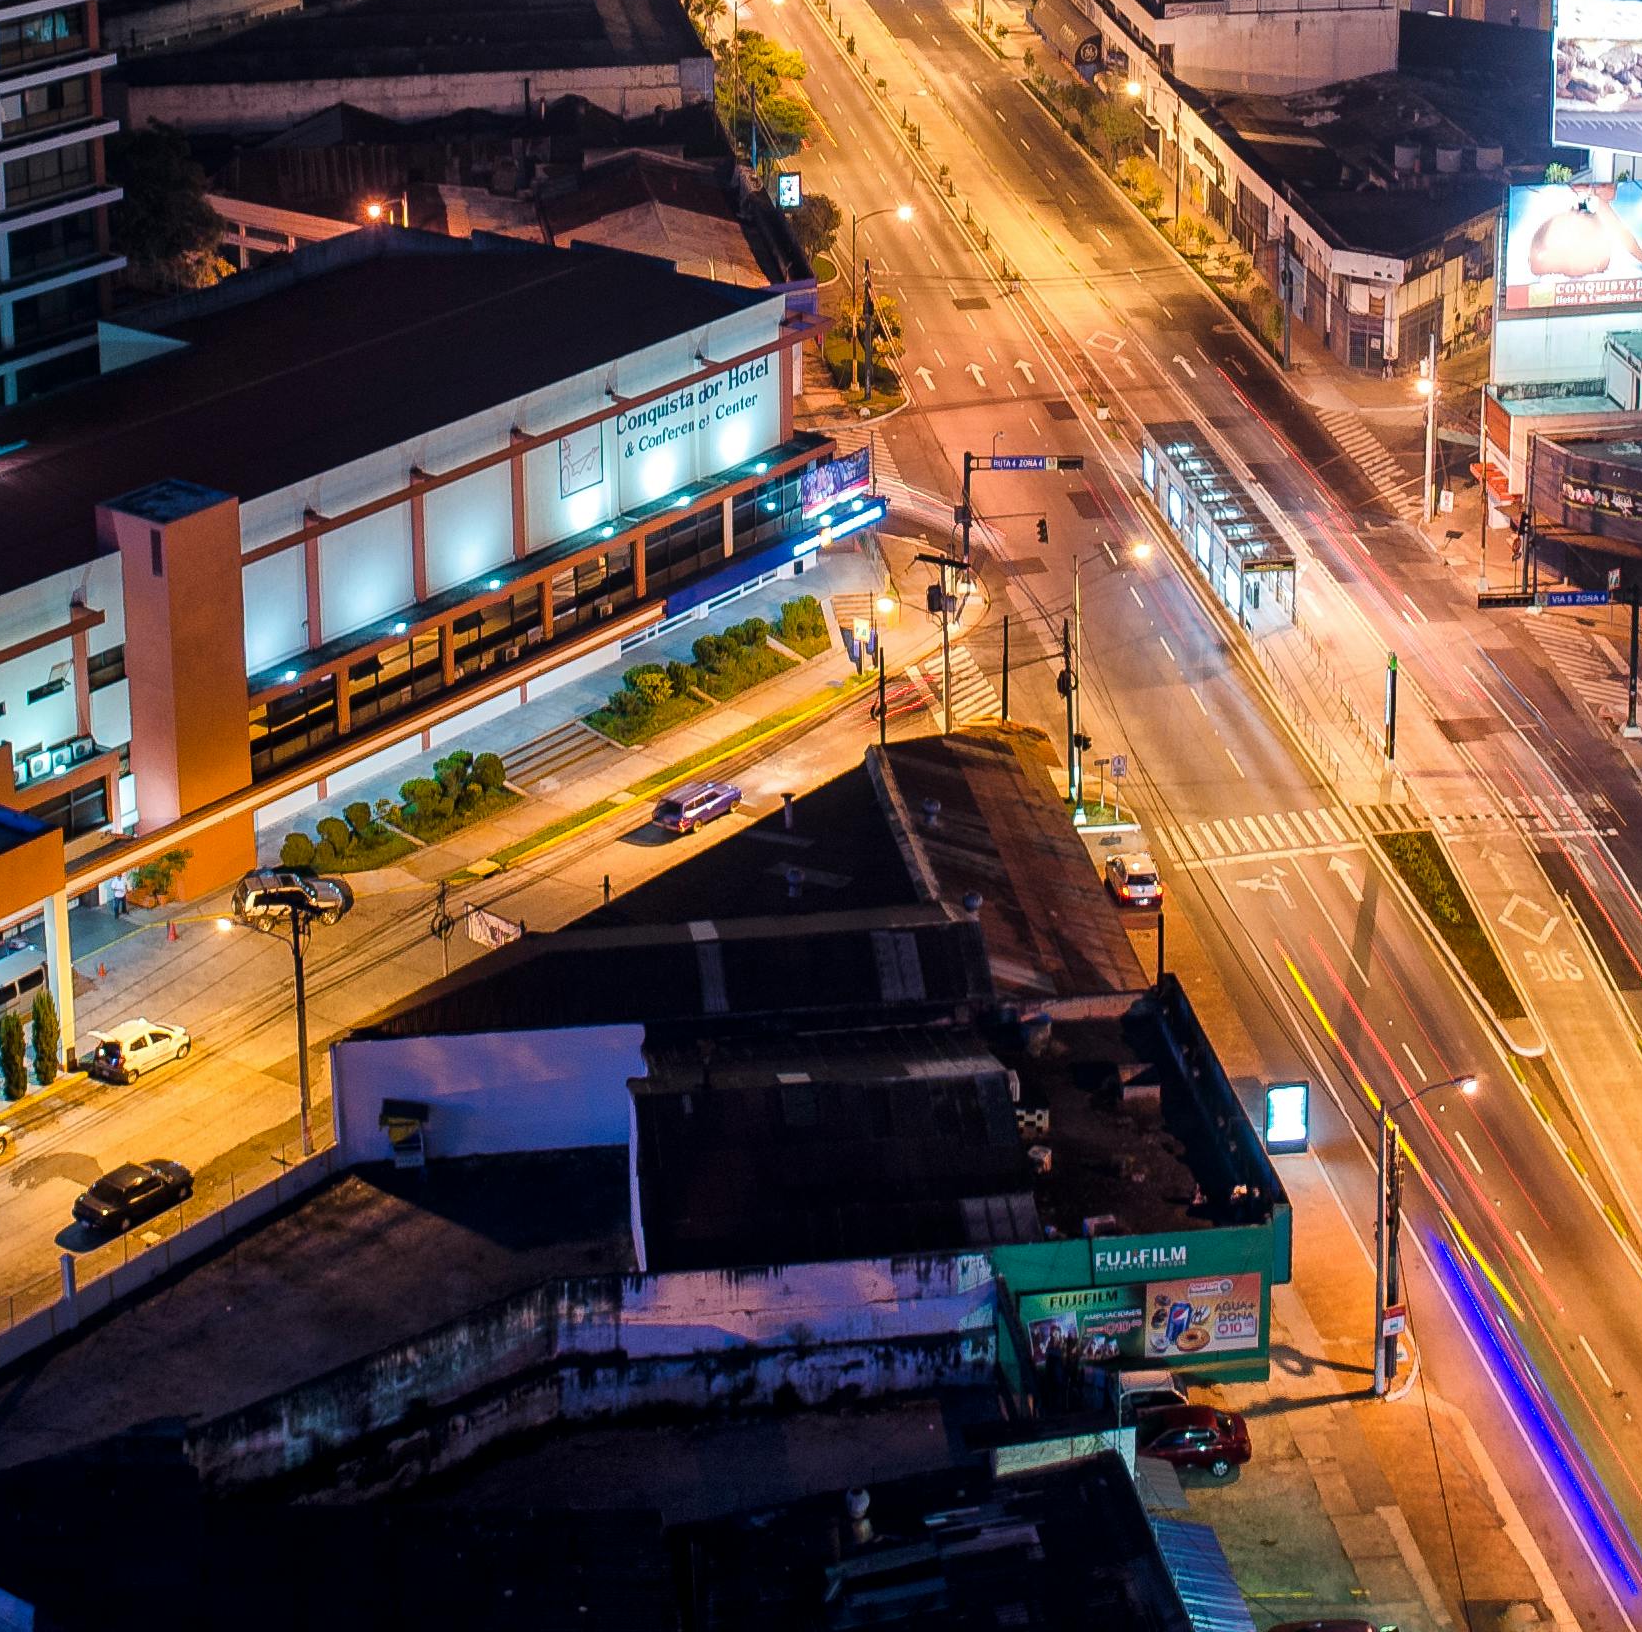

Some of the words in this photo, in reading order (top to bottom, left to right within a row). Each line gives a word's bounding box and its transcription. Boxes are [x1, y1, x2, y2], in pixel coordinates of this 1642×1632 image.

[727, 354, 770, 391] Hotel
[624, 441, 635, 459] &
[715, 393, 758, 420] Center
[993, 459, 1011, 468] RUTA
[1011, 459, 1017, 467] 4
[1018, 458, 1039, 468] ZONA
[1038, 458, 1043, 467] 4
[1576, 594, 1599, 603] ZONA
[1600, 594, 1606, 602] 4
[1095, 1245, 1187, 1267] FUJIFILM
[1049, 1289, 1118, 1308] FUJIFILM
